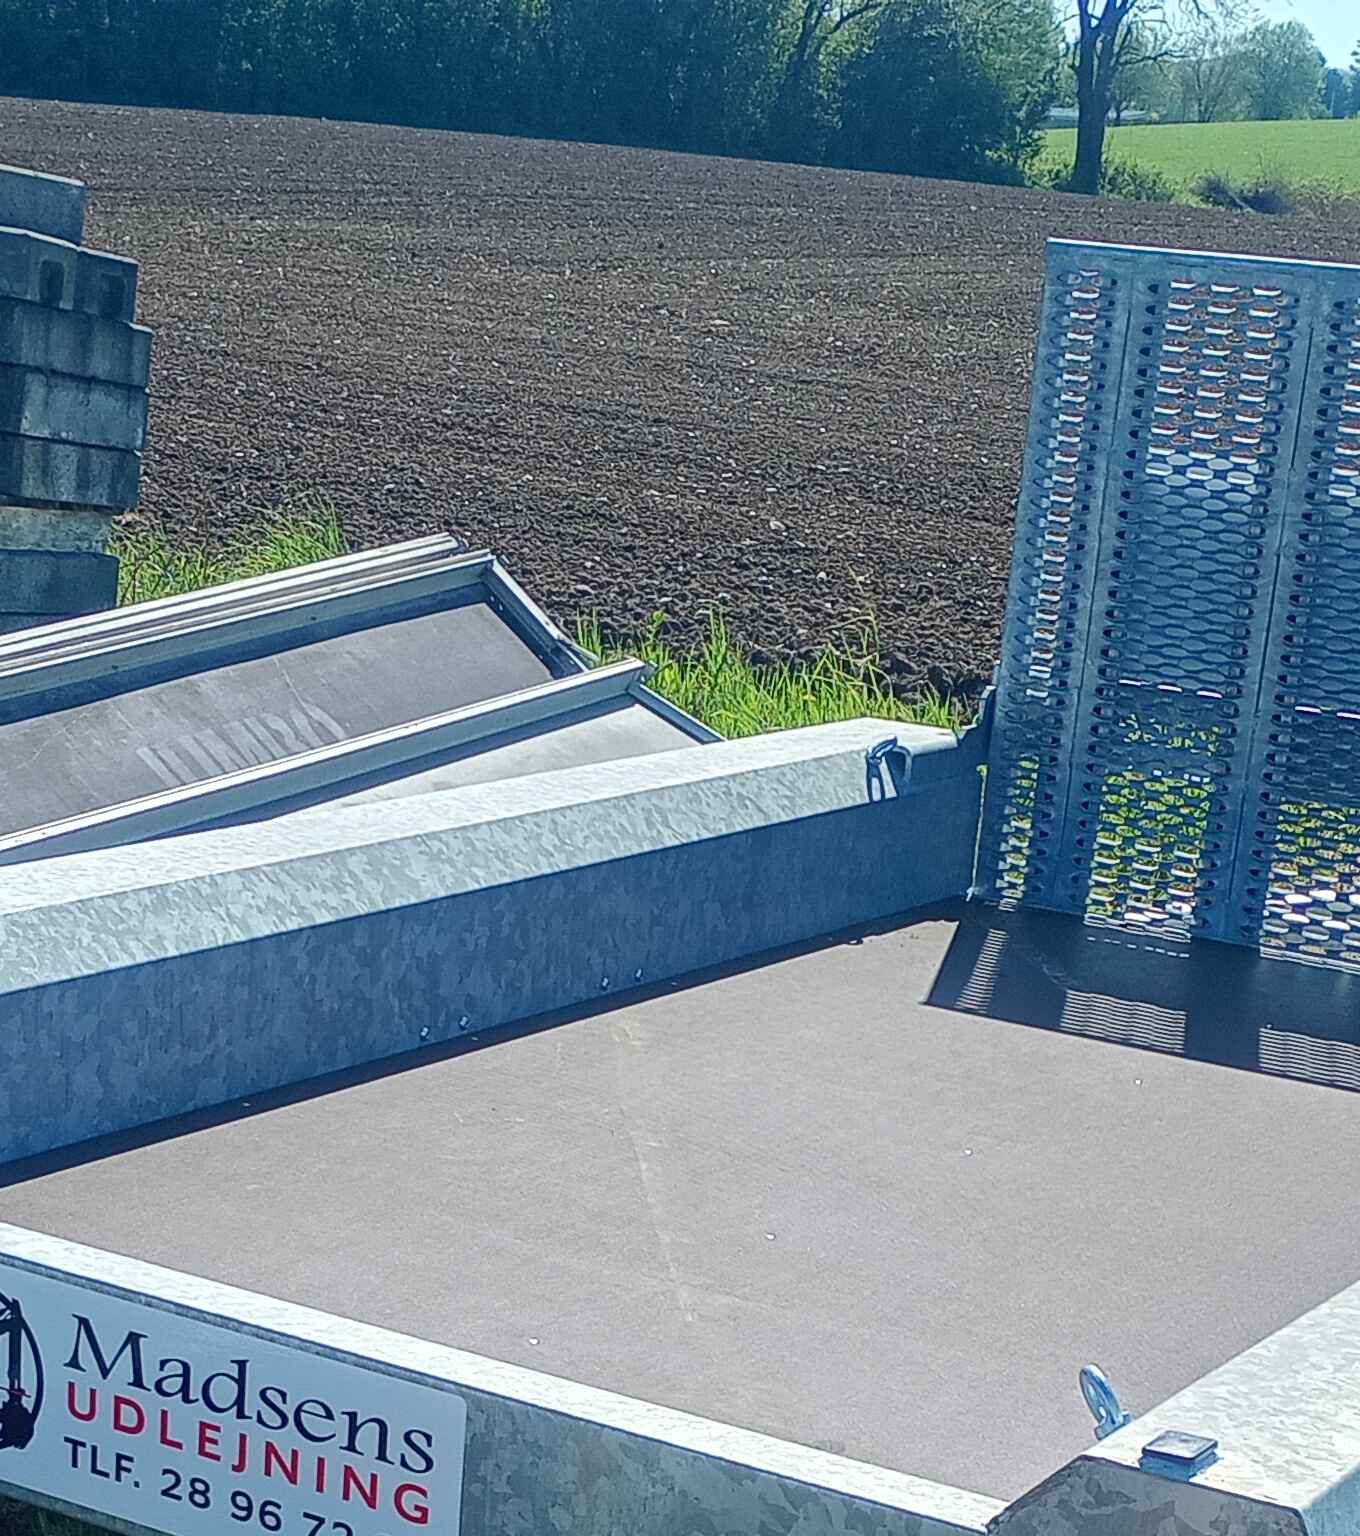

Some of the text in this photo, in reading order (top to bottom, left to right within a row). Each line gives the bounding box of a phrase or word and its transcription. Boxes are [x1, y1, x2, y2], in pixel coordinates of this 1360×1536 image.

[64, 1314, 434, 1473] Madsens
[66, 1381, 430, 1525] UDLEJNING
[63, 1436, 142, 1490] TLF.
[160, 1468, 212, 1510] 28
[230, 1490, 283, 1532] 96
